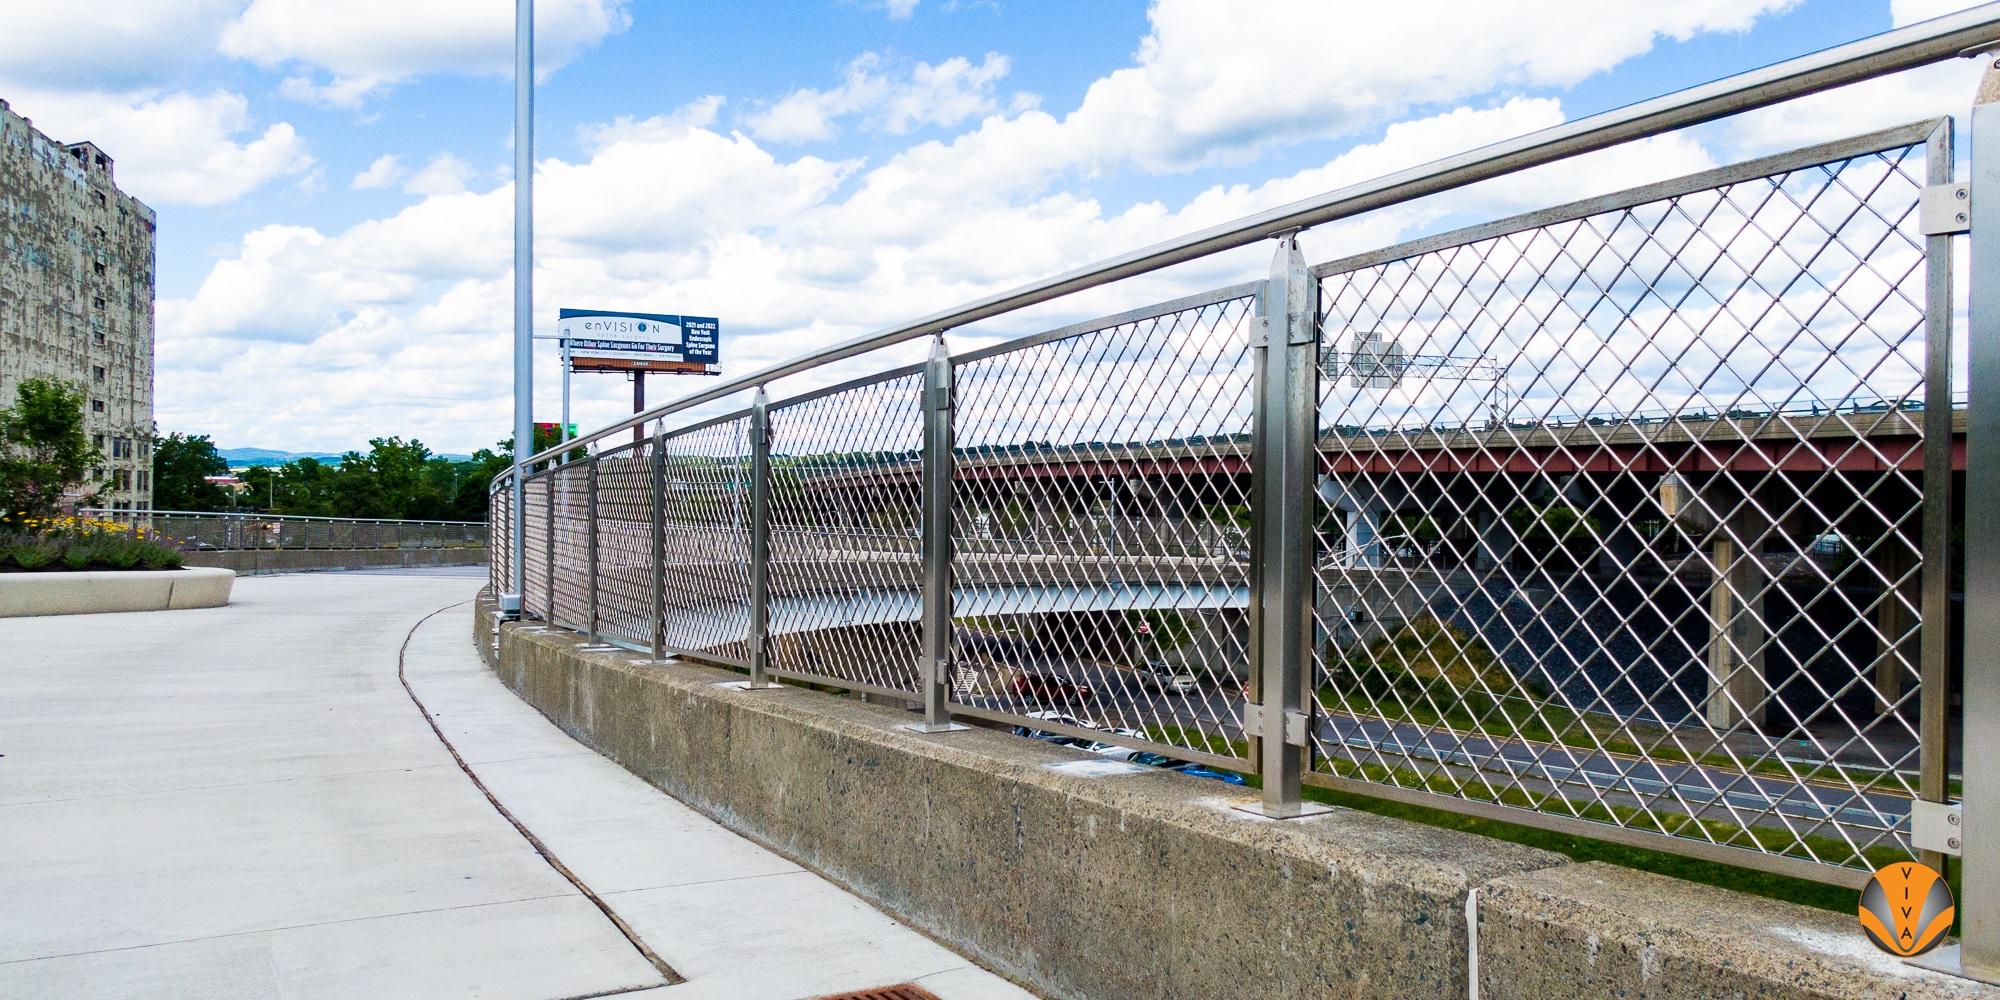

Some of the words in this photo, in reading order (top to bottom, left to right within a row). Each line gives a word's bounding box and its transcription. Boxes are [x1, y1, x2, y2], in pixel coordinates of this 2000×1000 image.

[584, 340, 597, 348] Other
[597, 341, 610, 349] Spine
[610, 341, 631, 350] Surgeons
[645, 343, 657, 351] Their
[657, 344, 674, 352] Surgery
